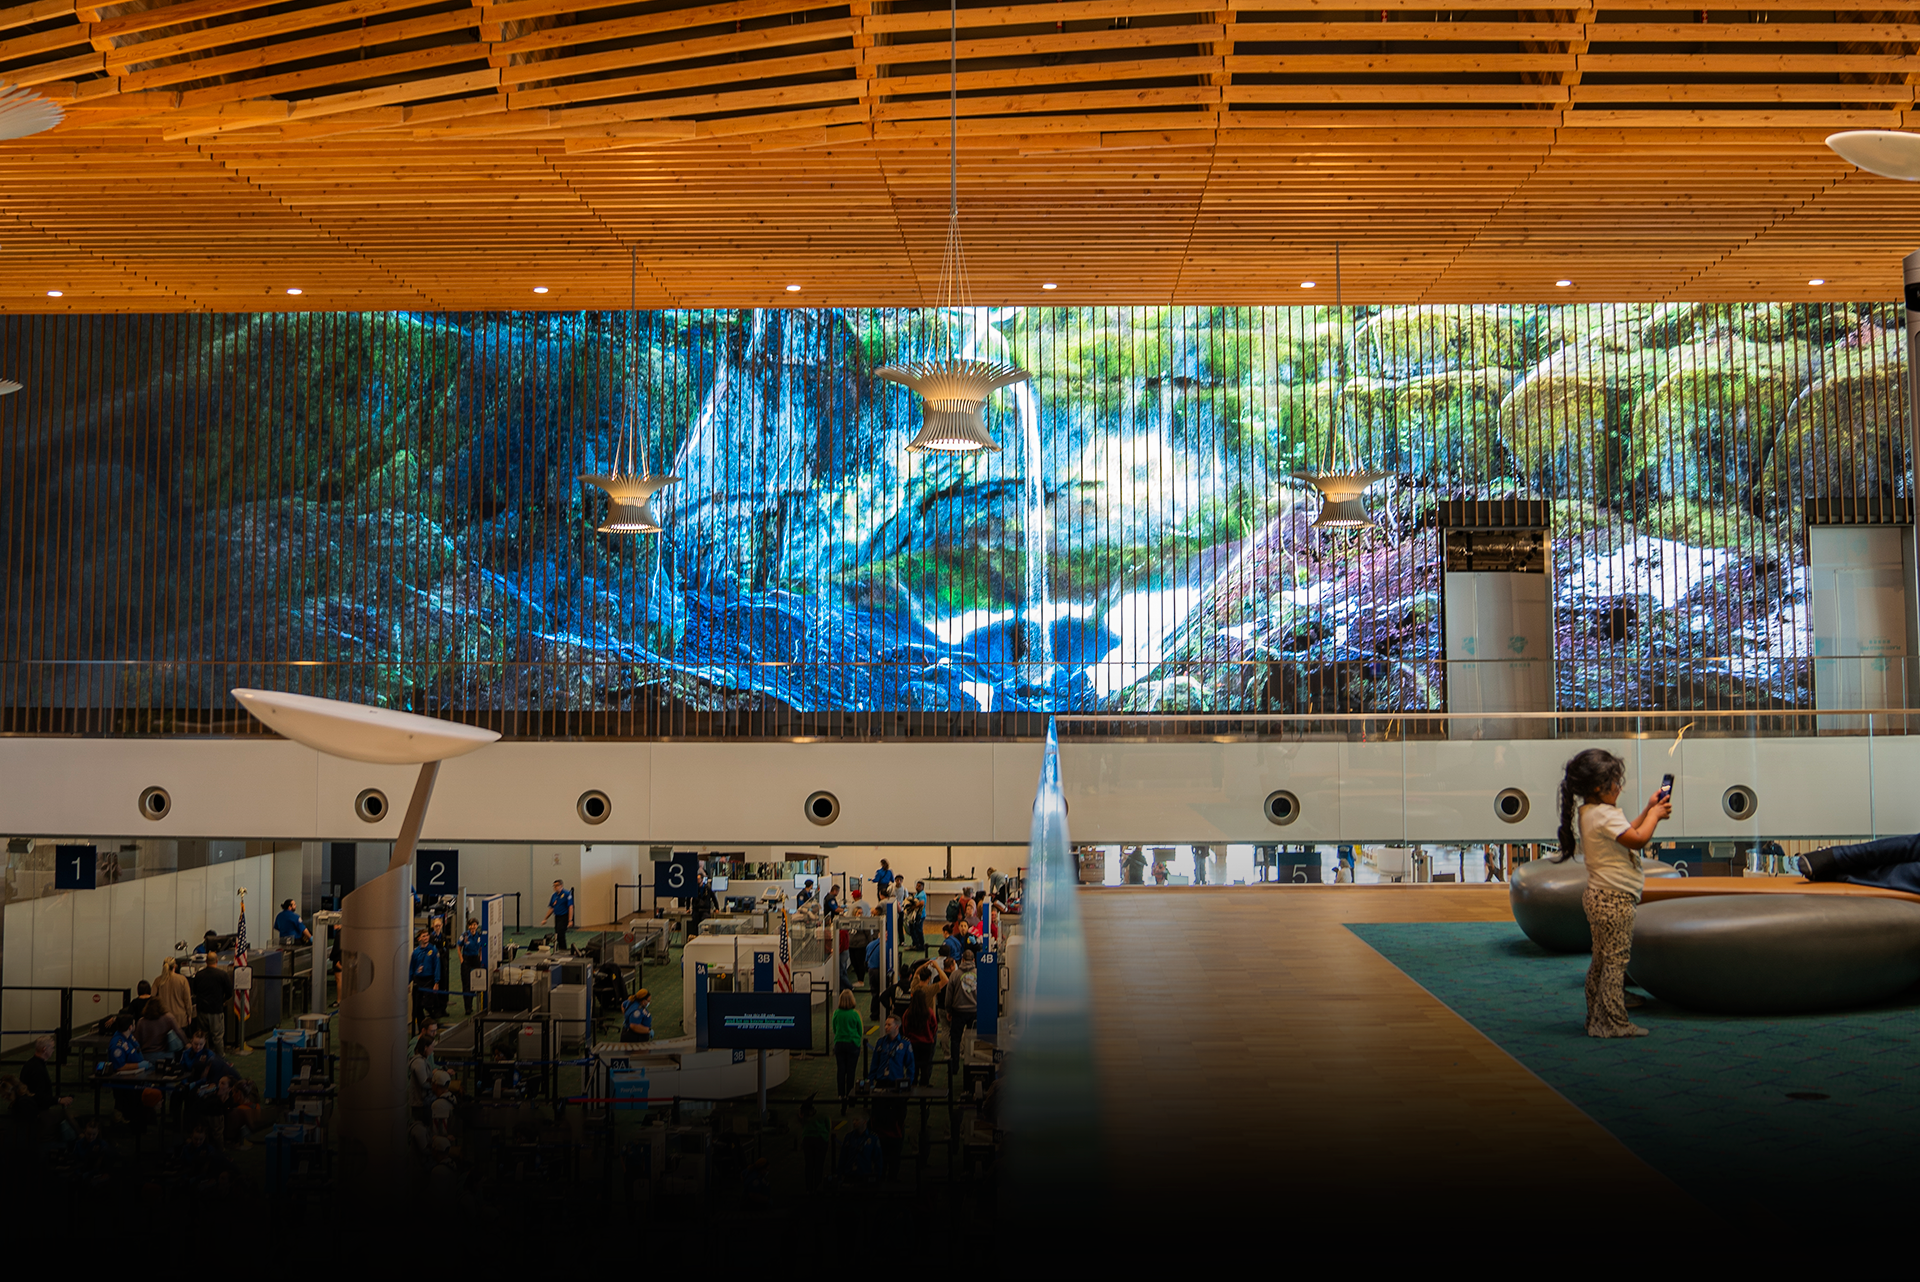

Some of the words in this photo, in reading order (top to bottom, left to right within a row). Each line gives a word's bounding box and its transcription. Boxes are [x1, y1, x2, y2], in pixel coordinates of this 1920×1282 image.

[71, 856, 81, 880] 1
[429, 861, 445, 885] 2
[1291, 864, 1308, 882] 5
[668, 863, 685, 888] 3
[757, 953, 771, 964] 3B
[980, 953, 994, 964] 4B
[697, 965, 706, 975] 3A
[734, 1050, 744, 1062] 3B
[613, 1060, 627, 1070] 3A
